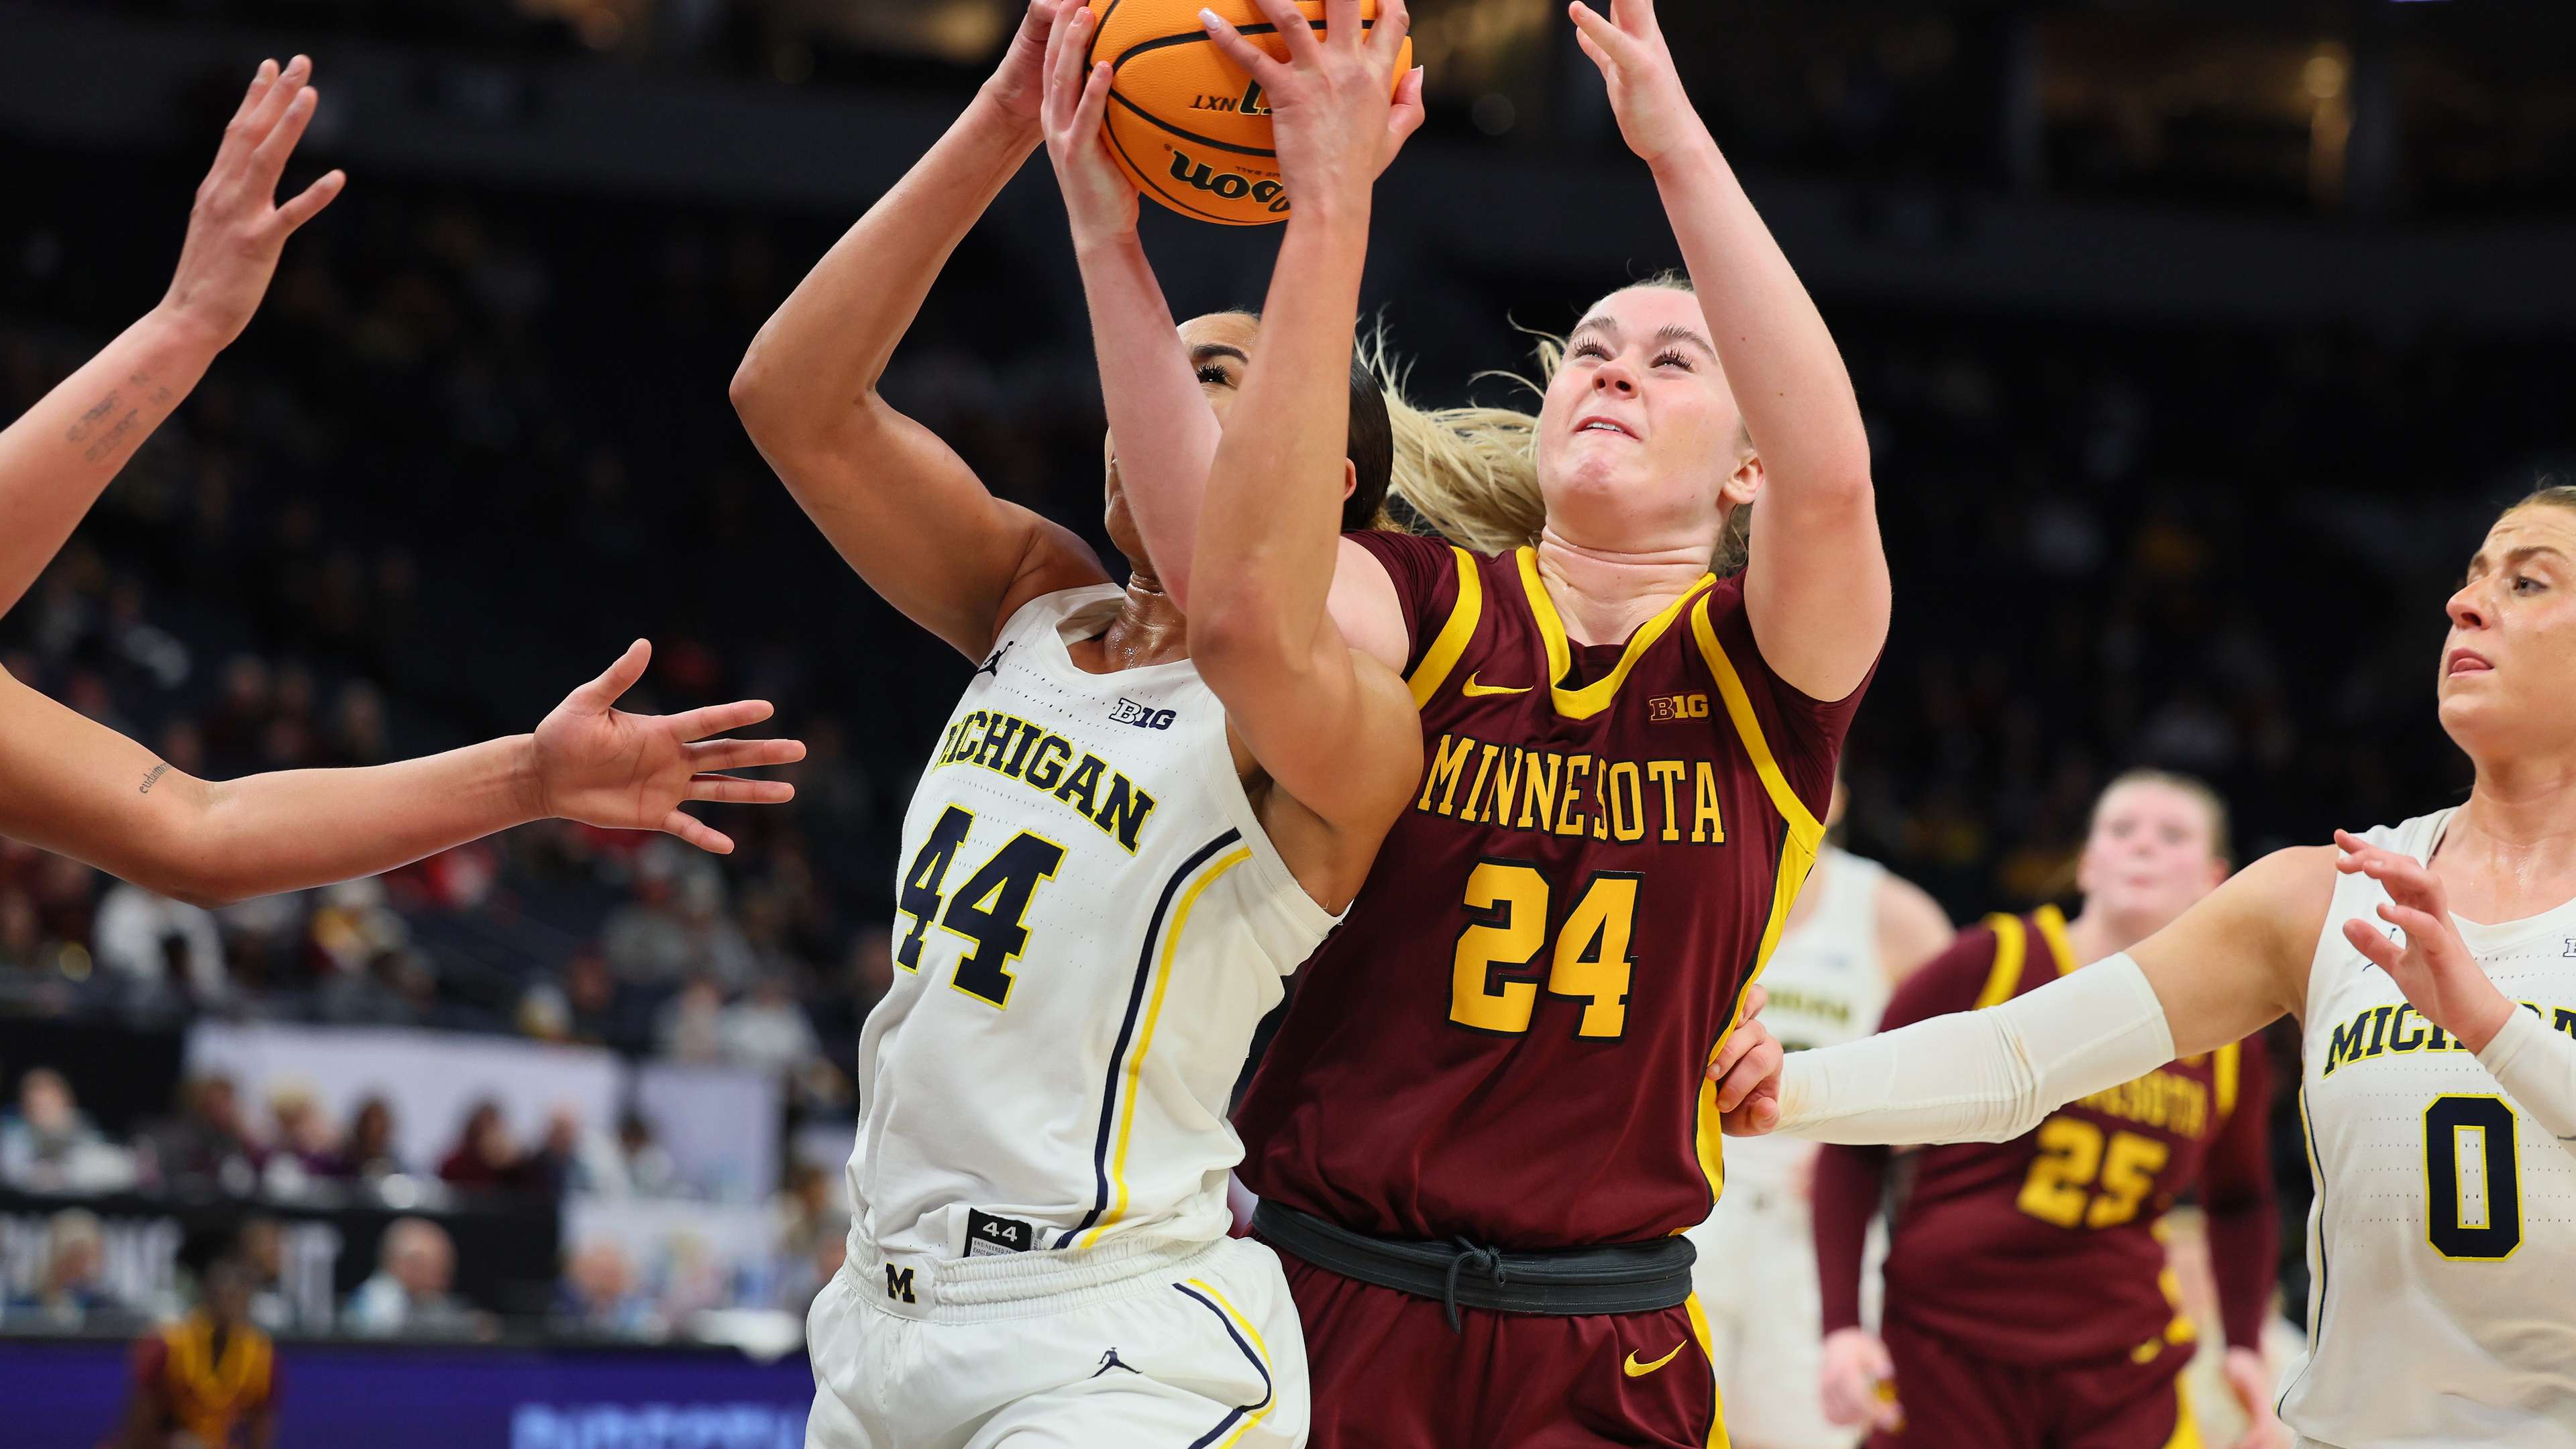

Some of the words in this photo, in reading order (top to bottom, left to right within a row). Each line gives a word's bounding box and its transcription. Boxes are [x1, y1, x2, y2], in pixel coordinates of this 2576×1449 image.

[1189, 95, 1238, 112] NXT
[1416, 733, 1727, 845] MINNESOTA
[896, 804, 1069, 1012] 44
[1446, 857, 1646, 1042] 24
[2016, 1115, 2170, 1230] 25
[2421, 1093, 2525, 1263] 0
[885, 1262, 916, 1304] M
[982, 1221, 1018, 1242] 44
